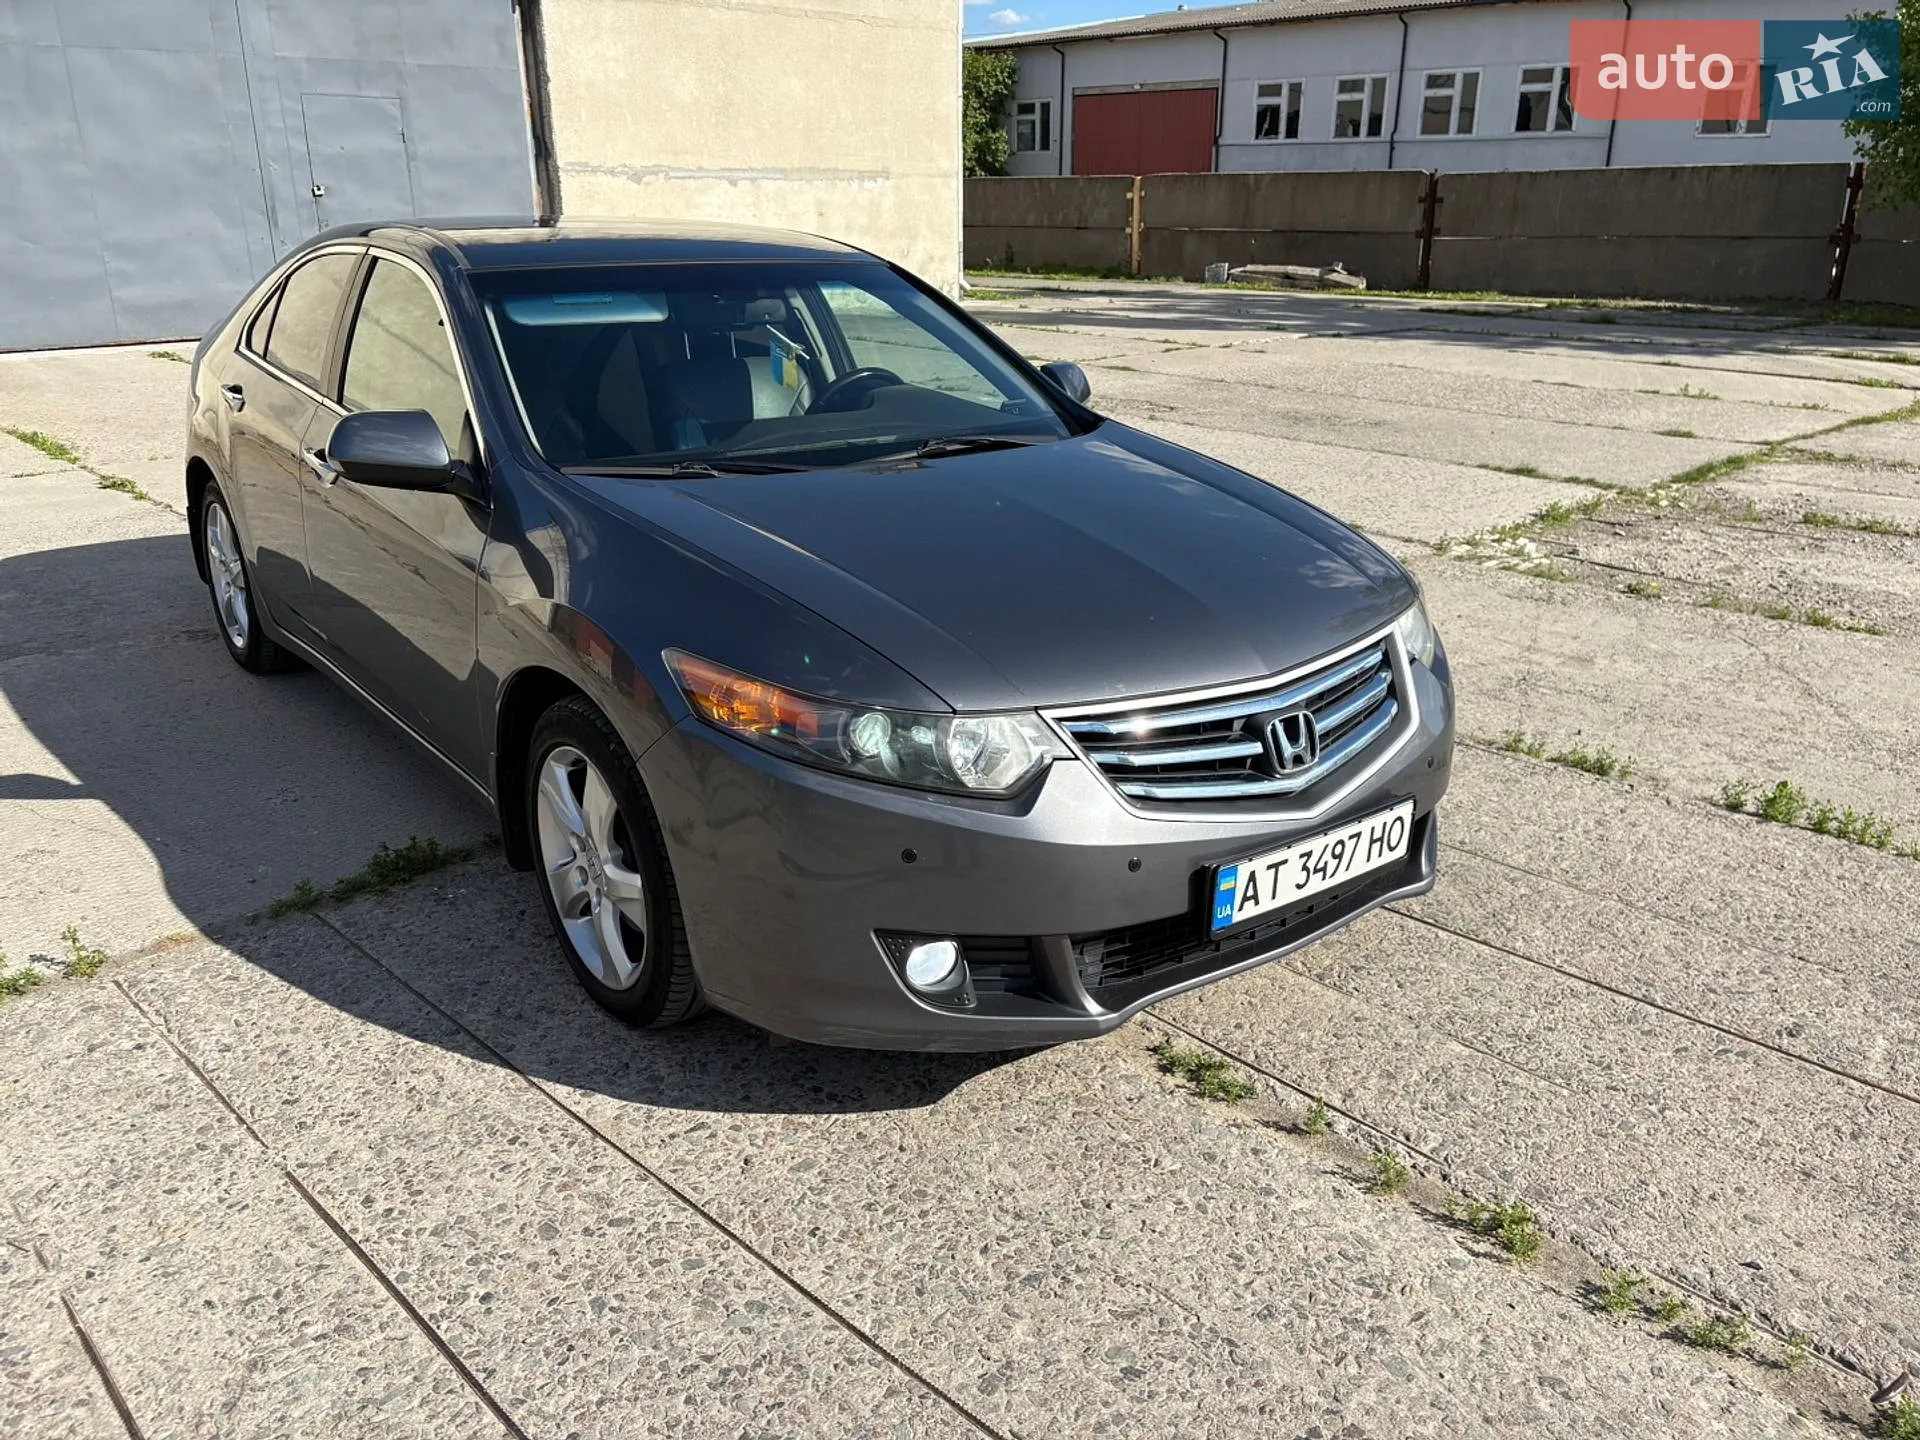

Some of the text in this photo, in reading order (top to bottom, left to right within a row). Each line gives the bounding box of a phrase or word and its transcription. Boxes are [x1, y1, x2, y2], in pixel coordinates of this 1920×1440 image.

[1238, 816, 1405, 912] AT 3497 HO
[1217, 904, 1231, 918] UA
